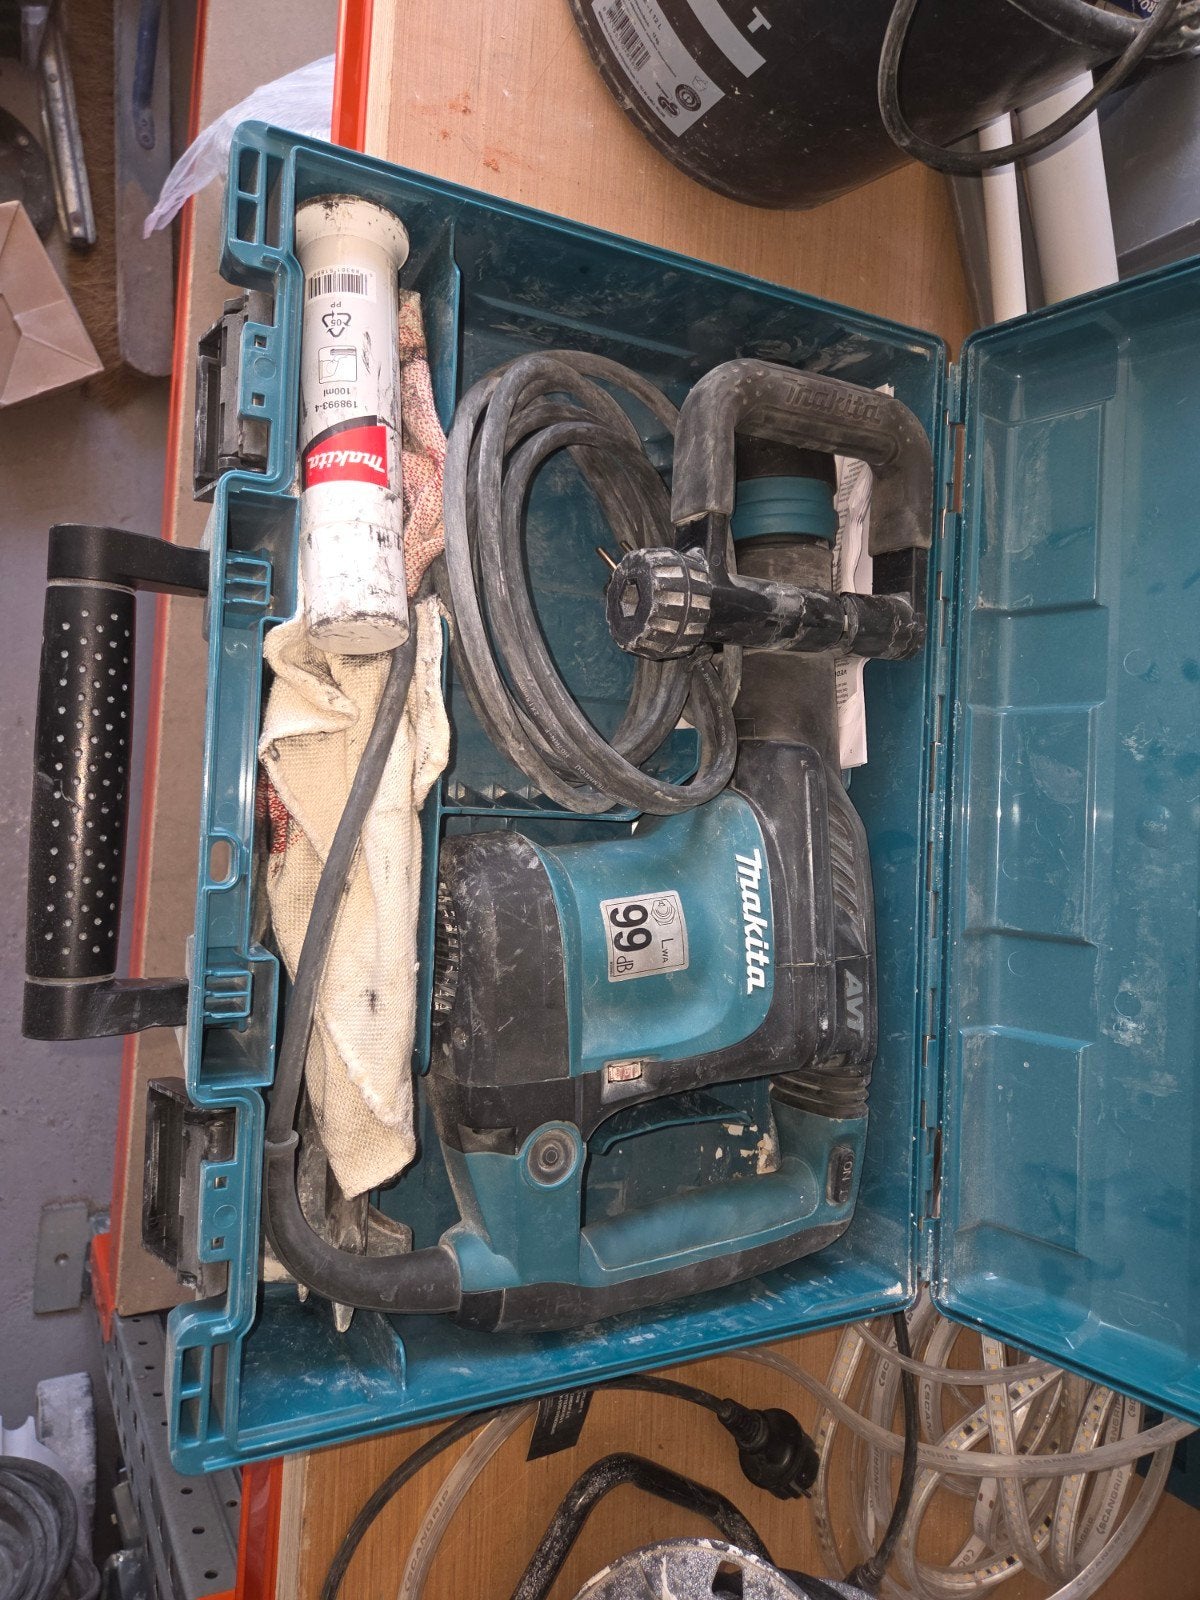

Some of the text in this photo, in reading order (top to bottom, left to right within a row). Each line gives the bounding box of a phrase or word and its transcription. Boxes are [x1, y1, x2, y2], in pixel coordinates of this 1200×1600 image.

[747, 6, 772, 34] T
[330, 319, 342, 327] 05
[323, 387, 351, 397] 100ml
[314, 399, 358, 413] 198993-4
[610, 904, 653, 974] 99 dB
[843, 968, 865, 1039] AVT
[841, 1161, 853, 1181] ON
